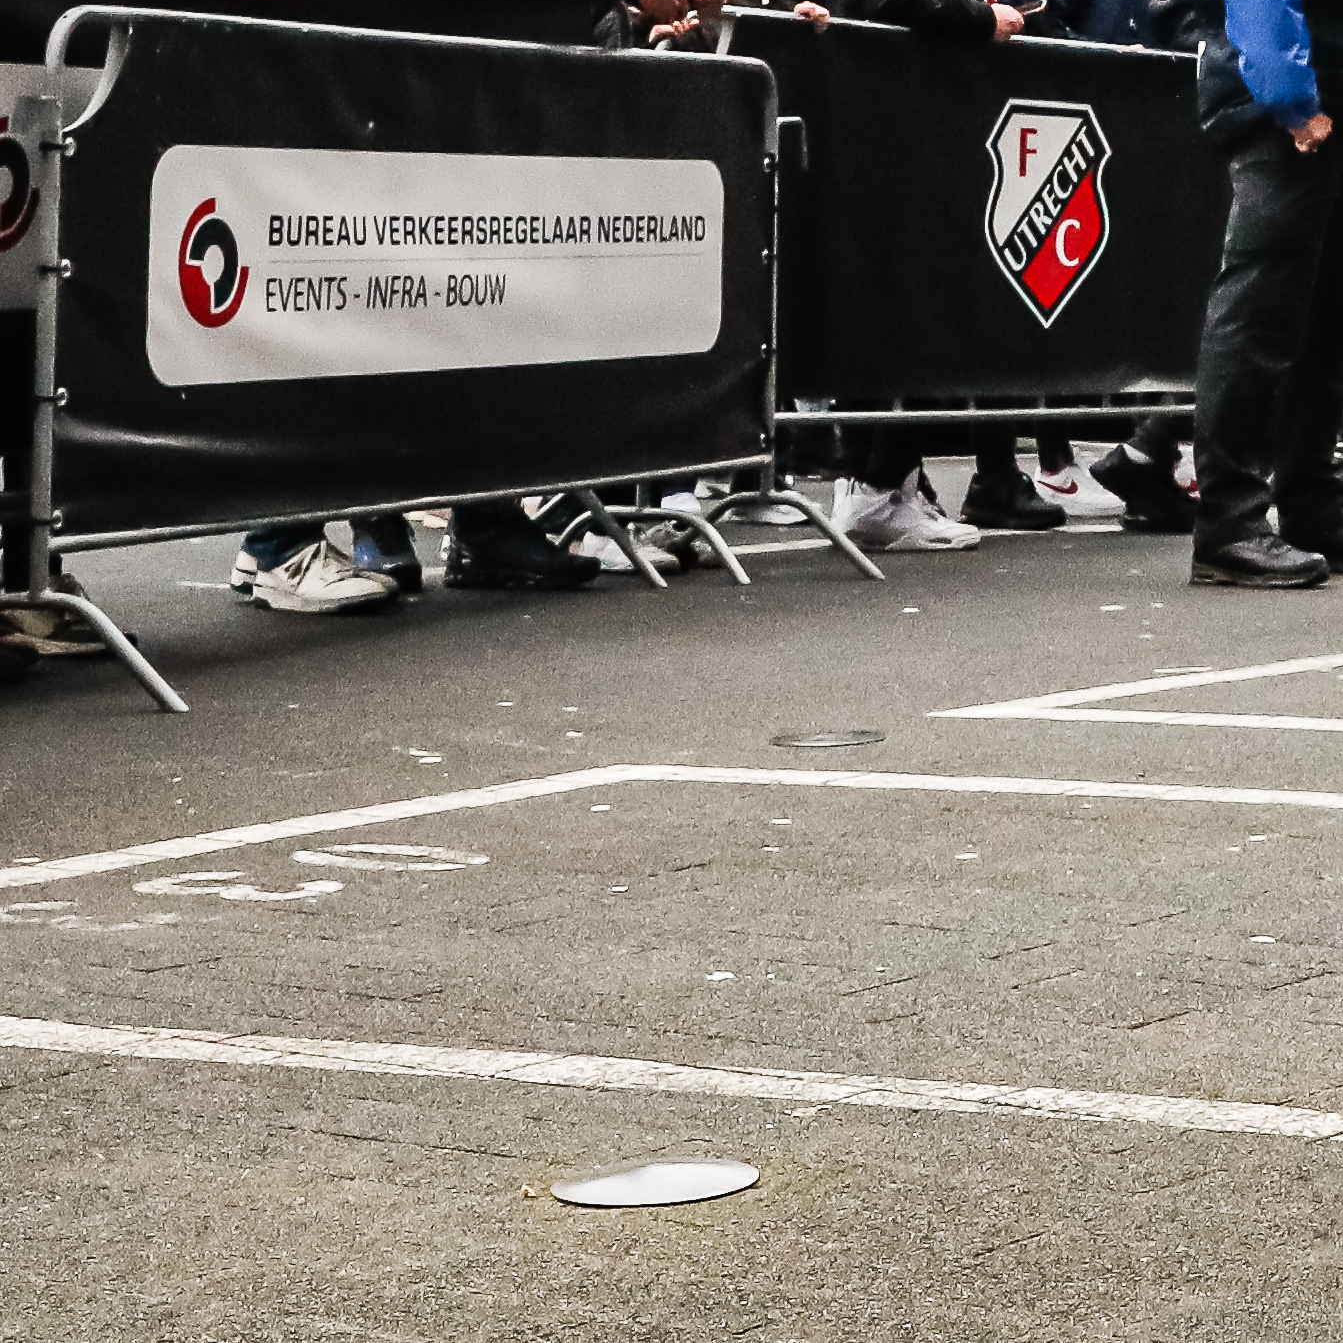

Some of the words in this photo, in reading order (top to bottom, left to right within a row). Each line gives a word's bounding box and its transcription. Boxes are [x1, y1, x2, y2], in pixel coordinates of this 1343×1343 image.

[1019, 127, 1038, 178] F
[1003, 125, 1096, 272] UTRECHT
[269, 215, 367, 246] BUREAU
[374, 214, 591, 245] VERKEERSREGELAAR
[598, 215, 706, 244] NEDERLAND
[1054, 218, 1082, 268] C
[266, 276, 348, 312] EVENTS
[366, 274, 427, 309] INFRA
[446, 273, 506, 308] BOUW
